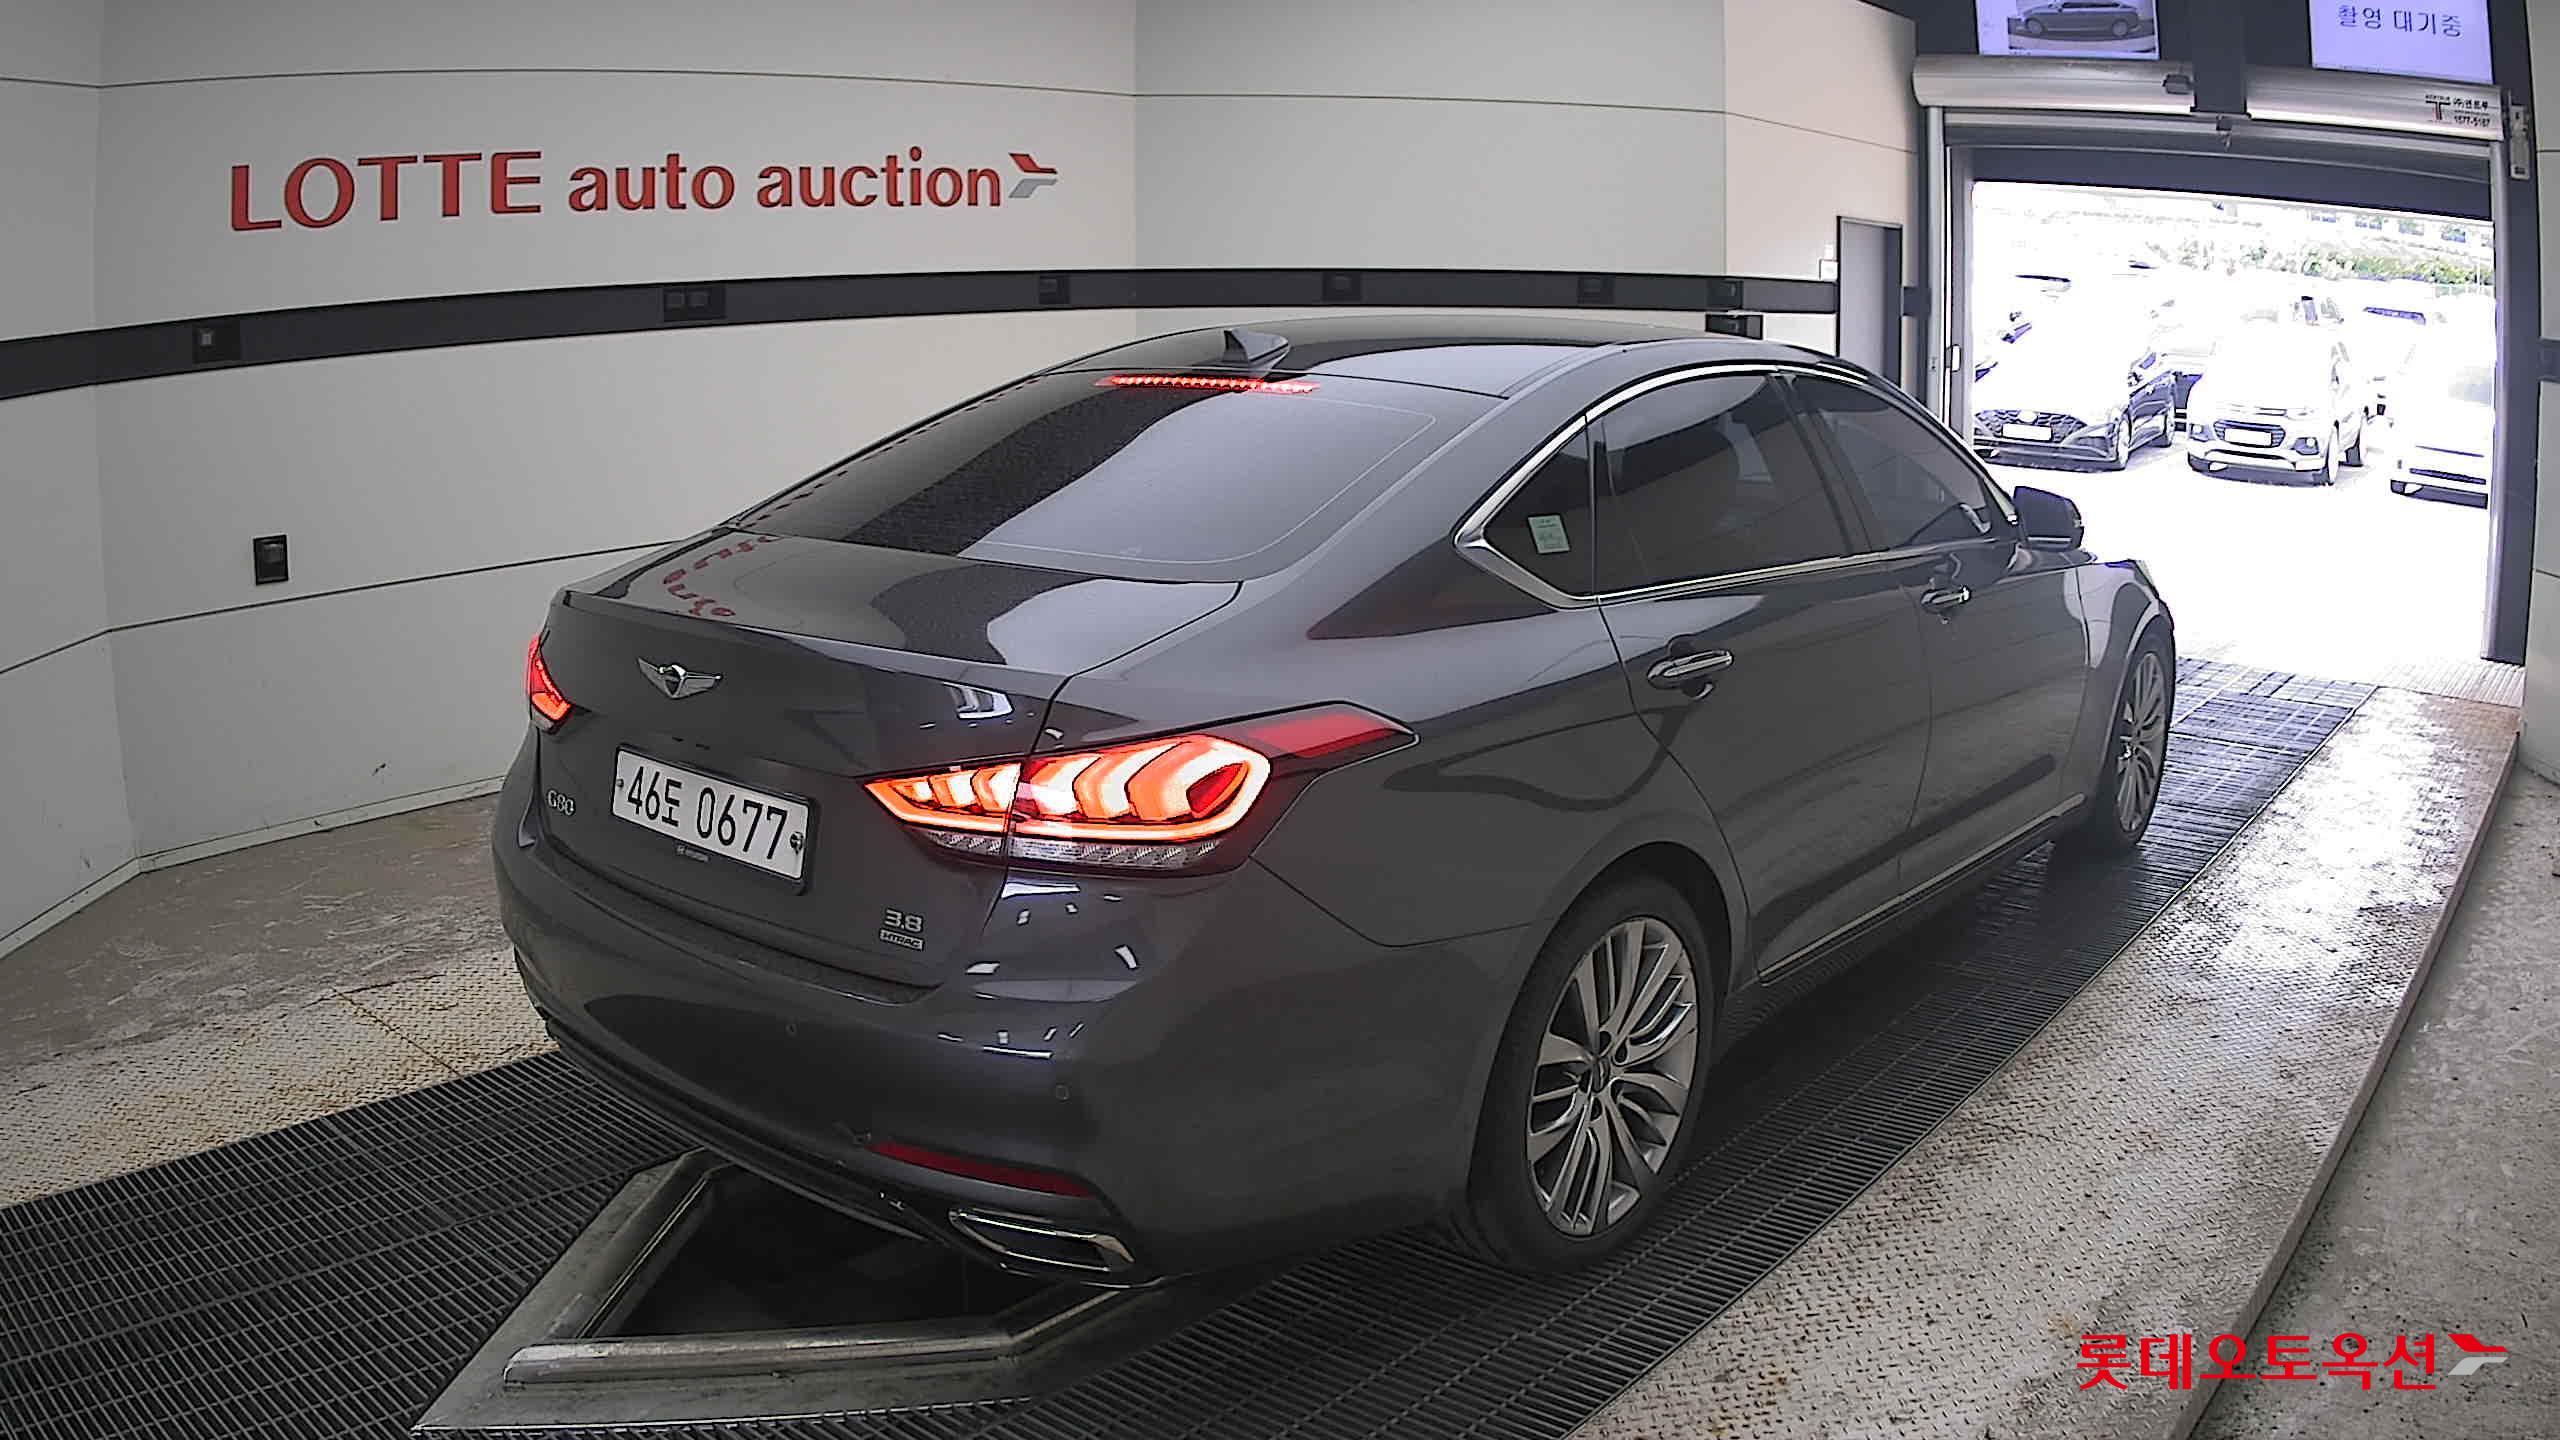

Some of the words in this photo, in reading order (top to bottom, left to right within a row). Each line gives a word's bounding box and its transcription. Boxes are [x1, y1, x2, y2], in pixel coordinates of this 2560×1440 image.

[2339, 5, 2382, 29] 촬영
[2393, 10, 2462, 38] 대기중
[231, 150, 542, 232] LOTTE
[568, 152, 735, 212] auto
[756, 145, 1002, 208] auction
[547, 789, 574, 816] G80
[627, 765, 683, 828] 46도
[696, 786, 788, 860] 0677
[884, 909, 922, 932] 3.8
